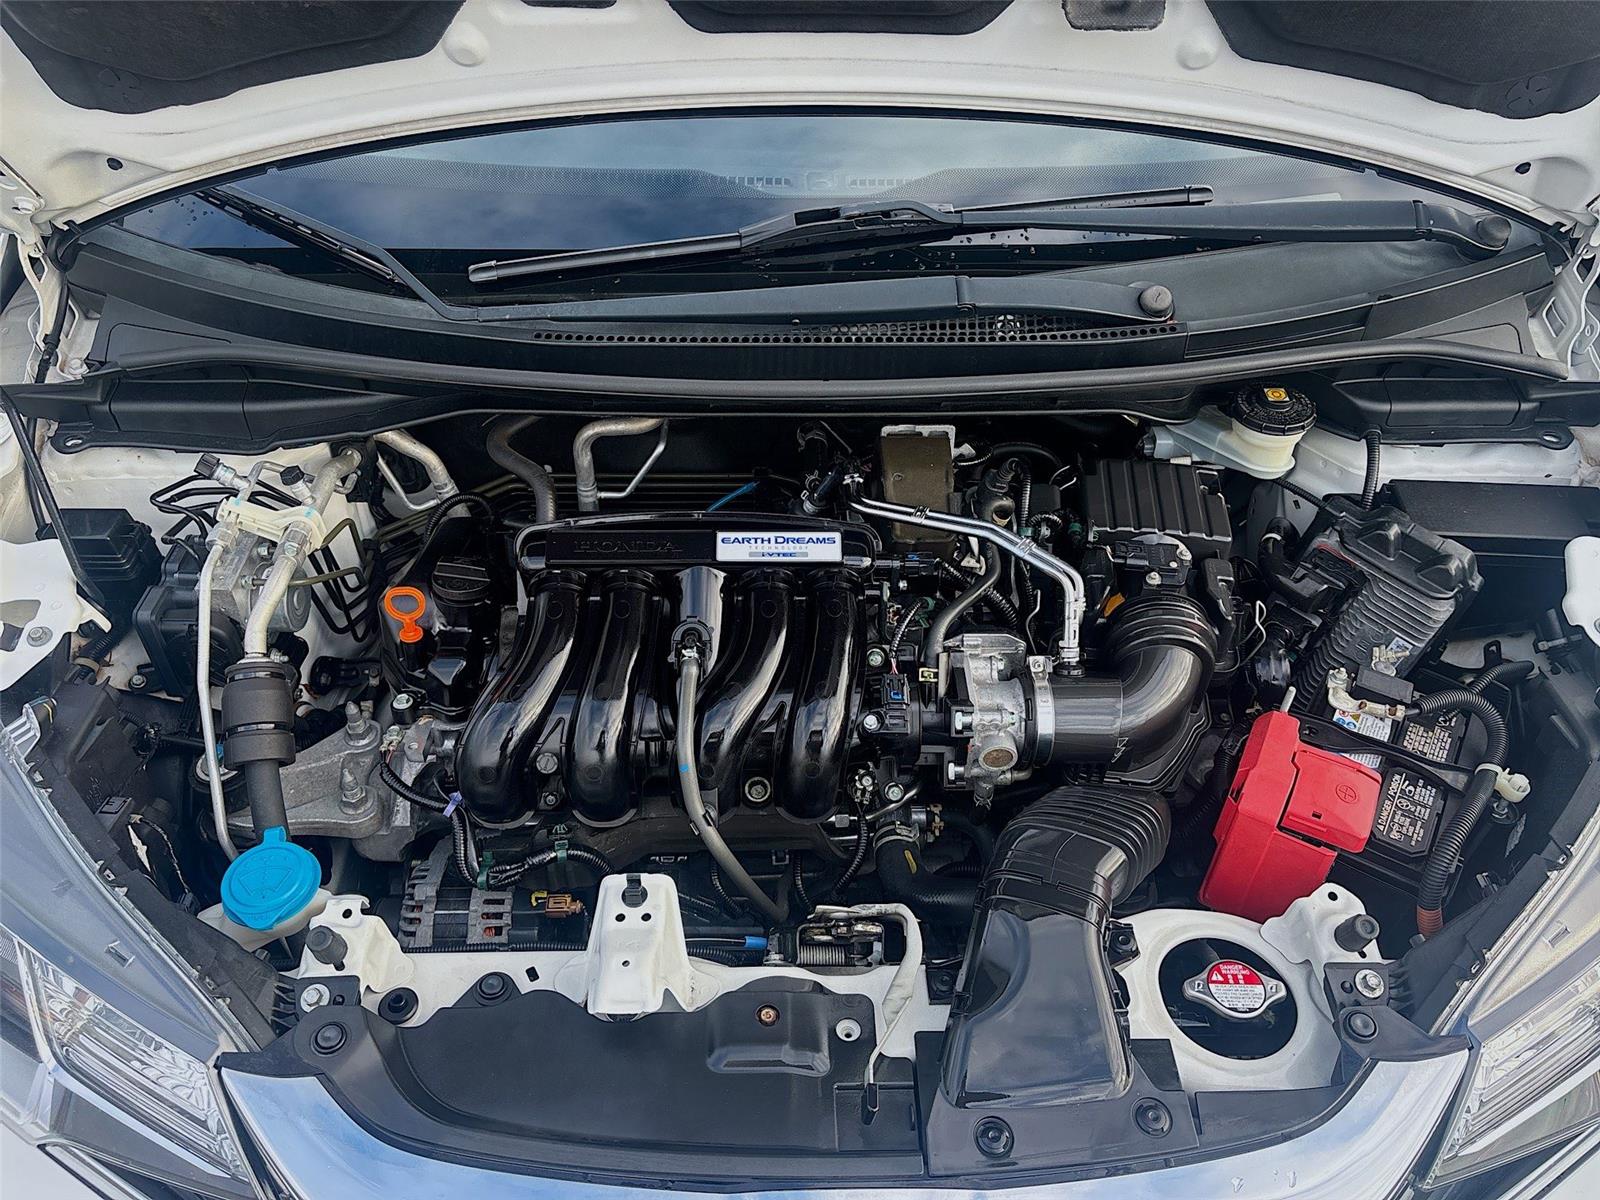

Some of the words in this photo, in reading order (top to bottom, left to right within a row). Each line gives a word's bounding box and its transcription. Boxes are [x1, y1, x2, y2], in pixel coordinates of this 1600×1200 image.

[574, 540, 684, 552] HONDA
[721, 536, 772, 545] EARTH
[774, 536, 837, 545] DREAMS
[1379, 800, 1393, 825] DANGER
[1388, 774, 1402, 796] POISON
